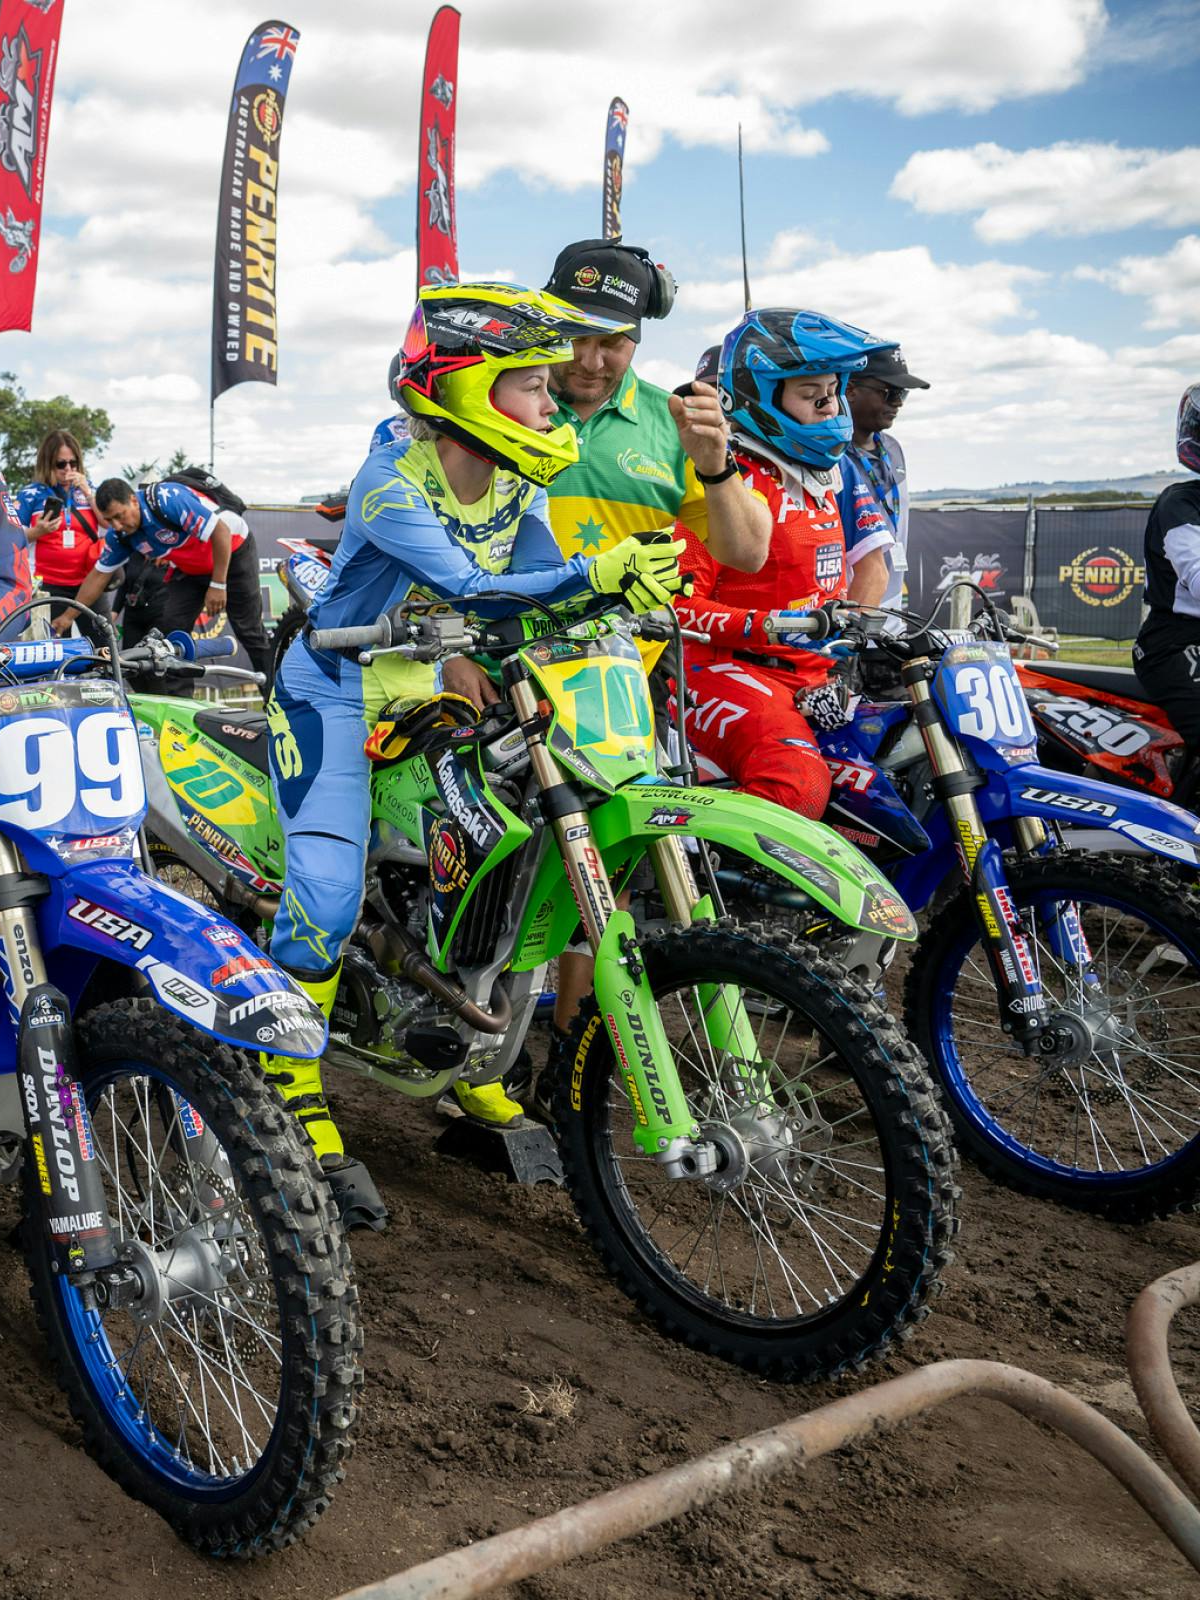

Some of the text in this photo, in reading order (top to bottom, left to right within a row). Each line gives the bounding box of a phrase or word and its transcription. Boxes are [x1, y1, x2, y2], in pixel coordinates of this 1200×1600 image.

[226, 95, 250, 362] AUSTRALIAN MADE AND OWNED
[245, 144, 279, 372] PENRITE
[574, 270, 602, 282] PENRITE
[603, 273, 641, 298] EMPIRE
[601, 285, 638, 307] Kawasaki
[448, 308, 514, 338] AMX
[293, 561, 331, 590] 469
[817, 557, 842, 577] USA
[1058, 565, 1145, 585] PENRITE
[563, 665, 653, 748] 10
[221, 724, 259, 741] GUTS
[1034, 696, 1150, 757] 250
[166, 758, 244, 810] 10
[830, 760, 876, 791] SA
[388, 793, 418, 827] KOKODA
[436, 749, 492, 848] Kawasaki
[1020, 786, 1118, 818] USA
[648, 814, 690, 825] AMX
[72, 835, 122, 851] USA
[189, 812, 239, 862] PENRITE
[429, 819, 470, 890] PENRITE
[68, 897, 153, 951] USA
[976, 891, 1002, 938] TAMER
[11, 923, 35, 985] enzo
[162, 978, 210, 1008] UFO
[30, 1012, 62, 1025] enzo
[271, 1014, 325, 1036] YAMAHA
[570, 1012, 602, 1112] GEOMA
[627, 1012, 673, 1125] DUNLOP
[22, 1072, 41, 1123] SKDA
[626, 1073, 649, 1126] TAMER
[37, 1046, 80, 1202] DUNLOP
[49, 1210, 103, 1234] YAMALUBE
